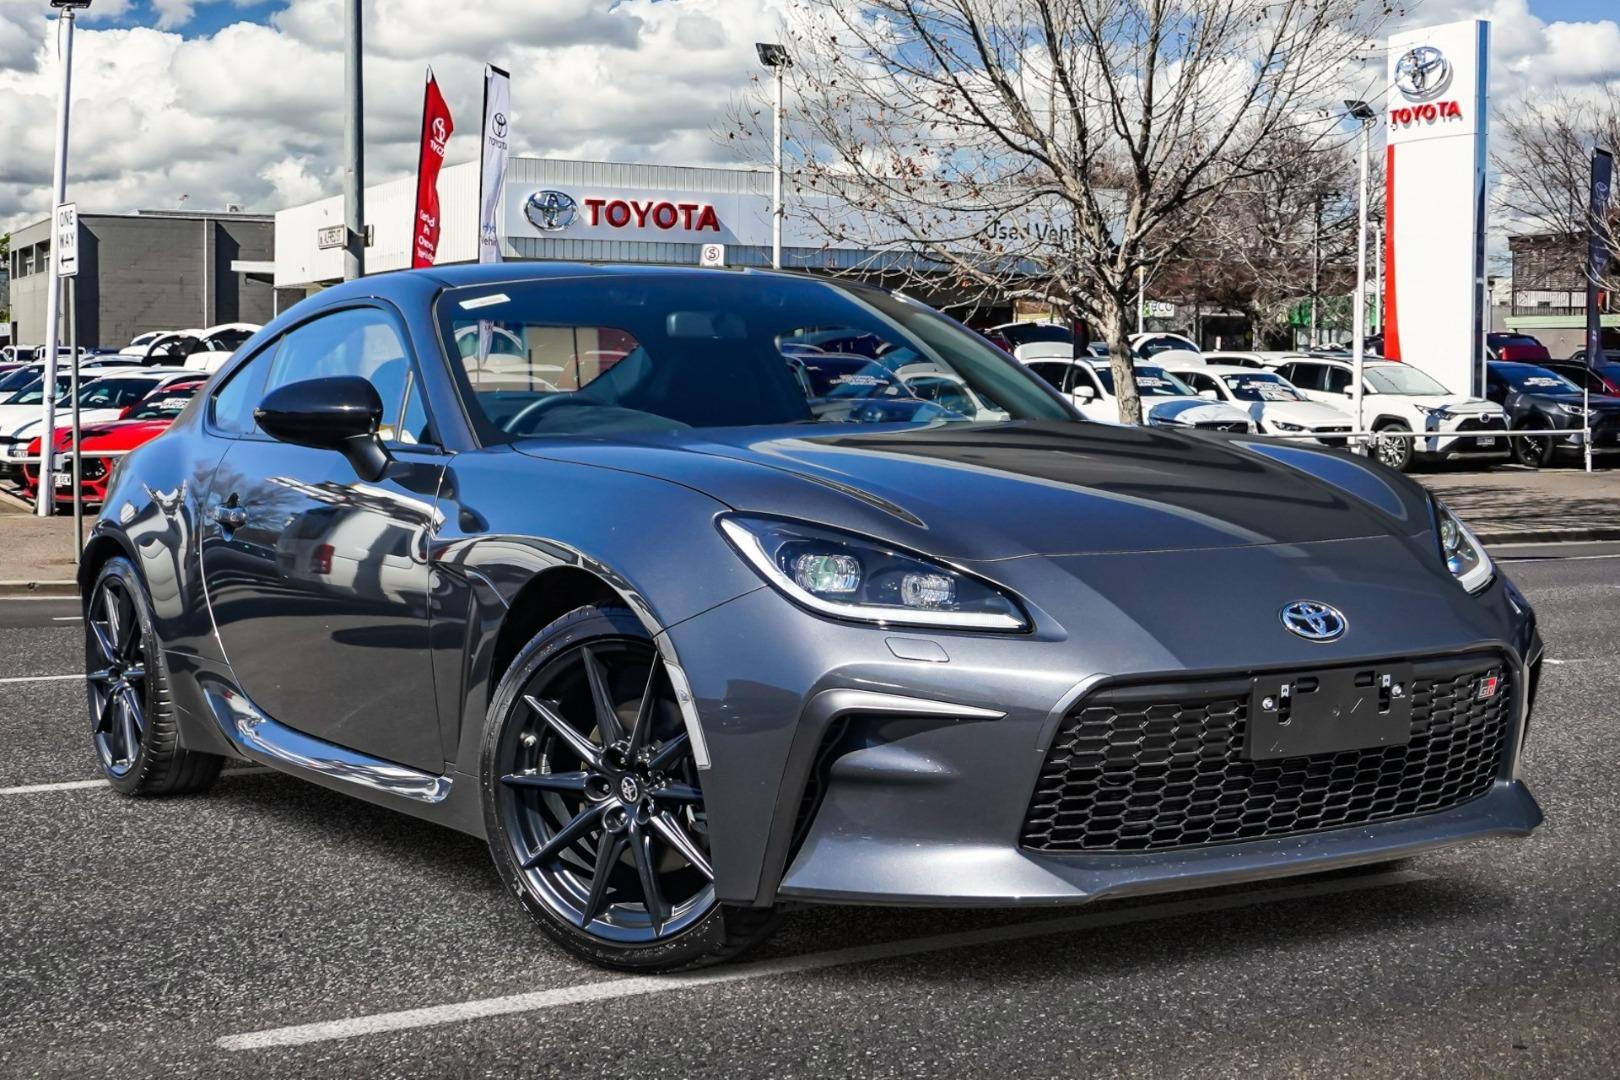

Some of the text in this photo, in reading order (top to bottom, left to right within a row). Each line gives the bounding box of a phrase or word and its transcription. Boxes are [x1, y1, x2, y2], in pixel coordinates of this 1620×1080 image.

[1389, 101, 1462, 124] TOYOTA
[60, 209, 74, 228] ONE
[584, 198, 720, 232] TOYOTA
[60, 231, 75, 248] WAY
[985, 220, 1030, 240] Used
